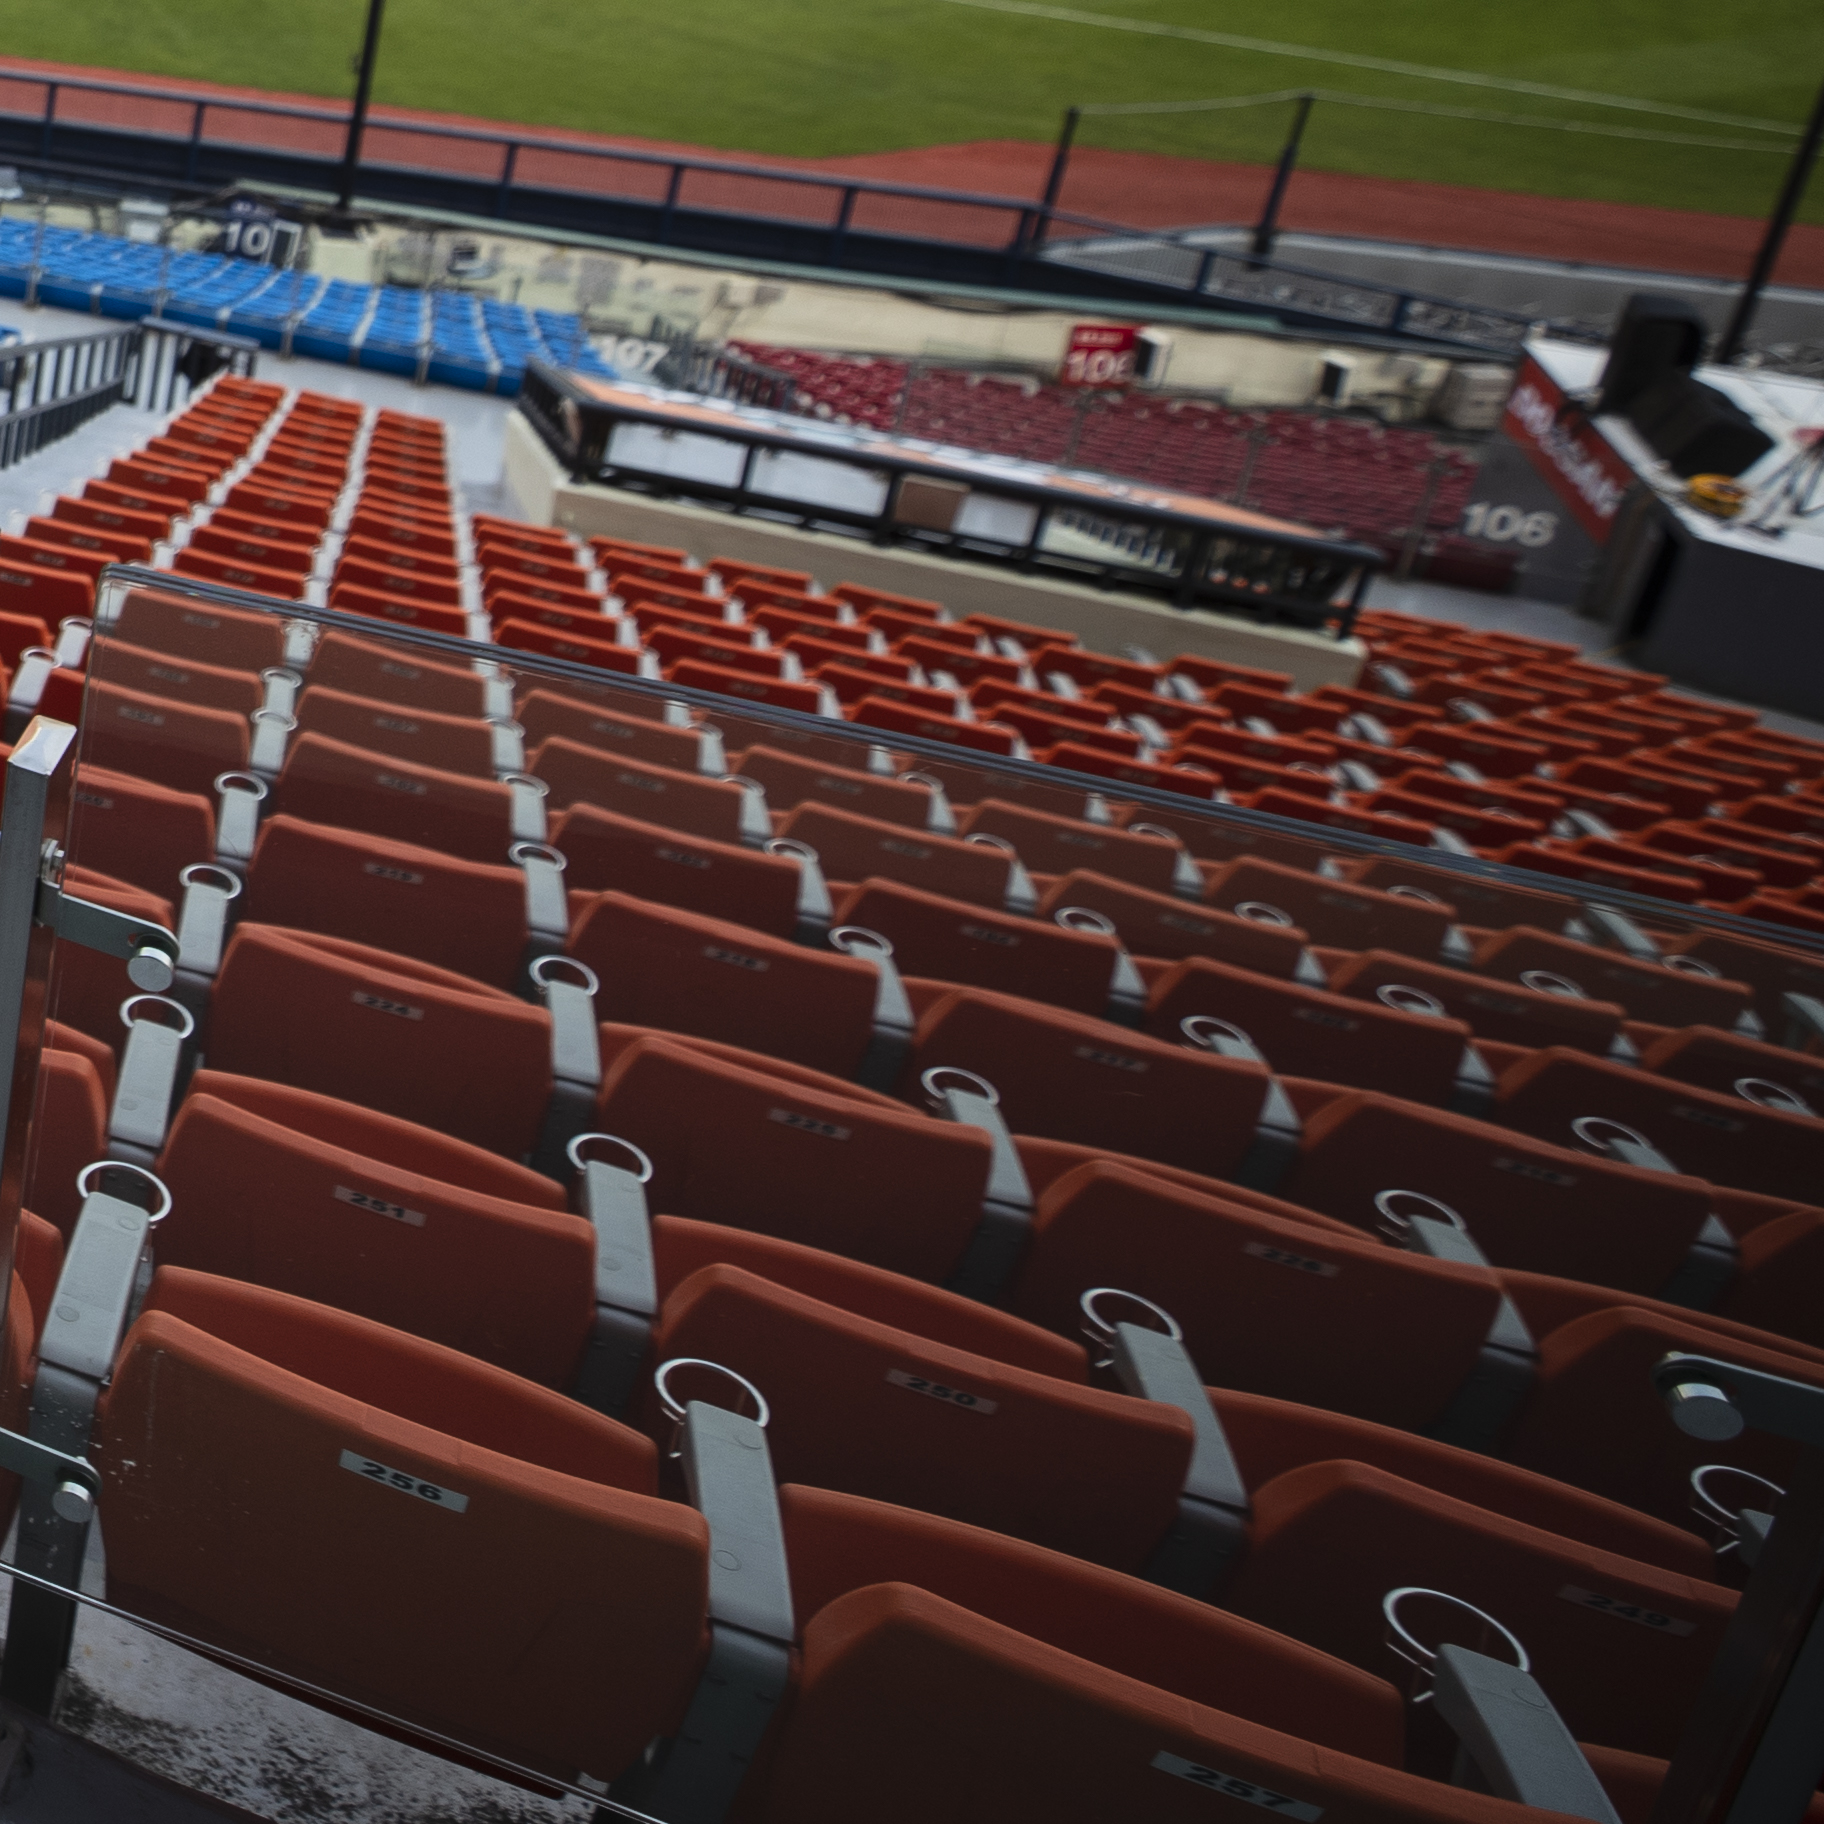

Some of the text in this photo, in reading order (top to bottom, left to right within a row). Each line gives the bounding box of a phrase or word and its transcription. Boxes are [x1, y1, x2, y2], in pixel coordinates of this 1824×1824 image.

[1463, 502, 1559, 548] 106
[365, 995, 409, 1015] 224
[351, 1191, 406, 1218] 251
[906, 1375, 978, 1407] 250
[361, 1460, 444, 1503] 256
[1585, 1593, 1671, 1628] 249
[1183, 1763, 1295, 1810] 257
